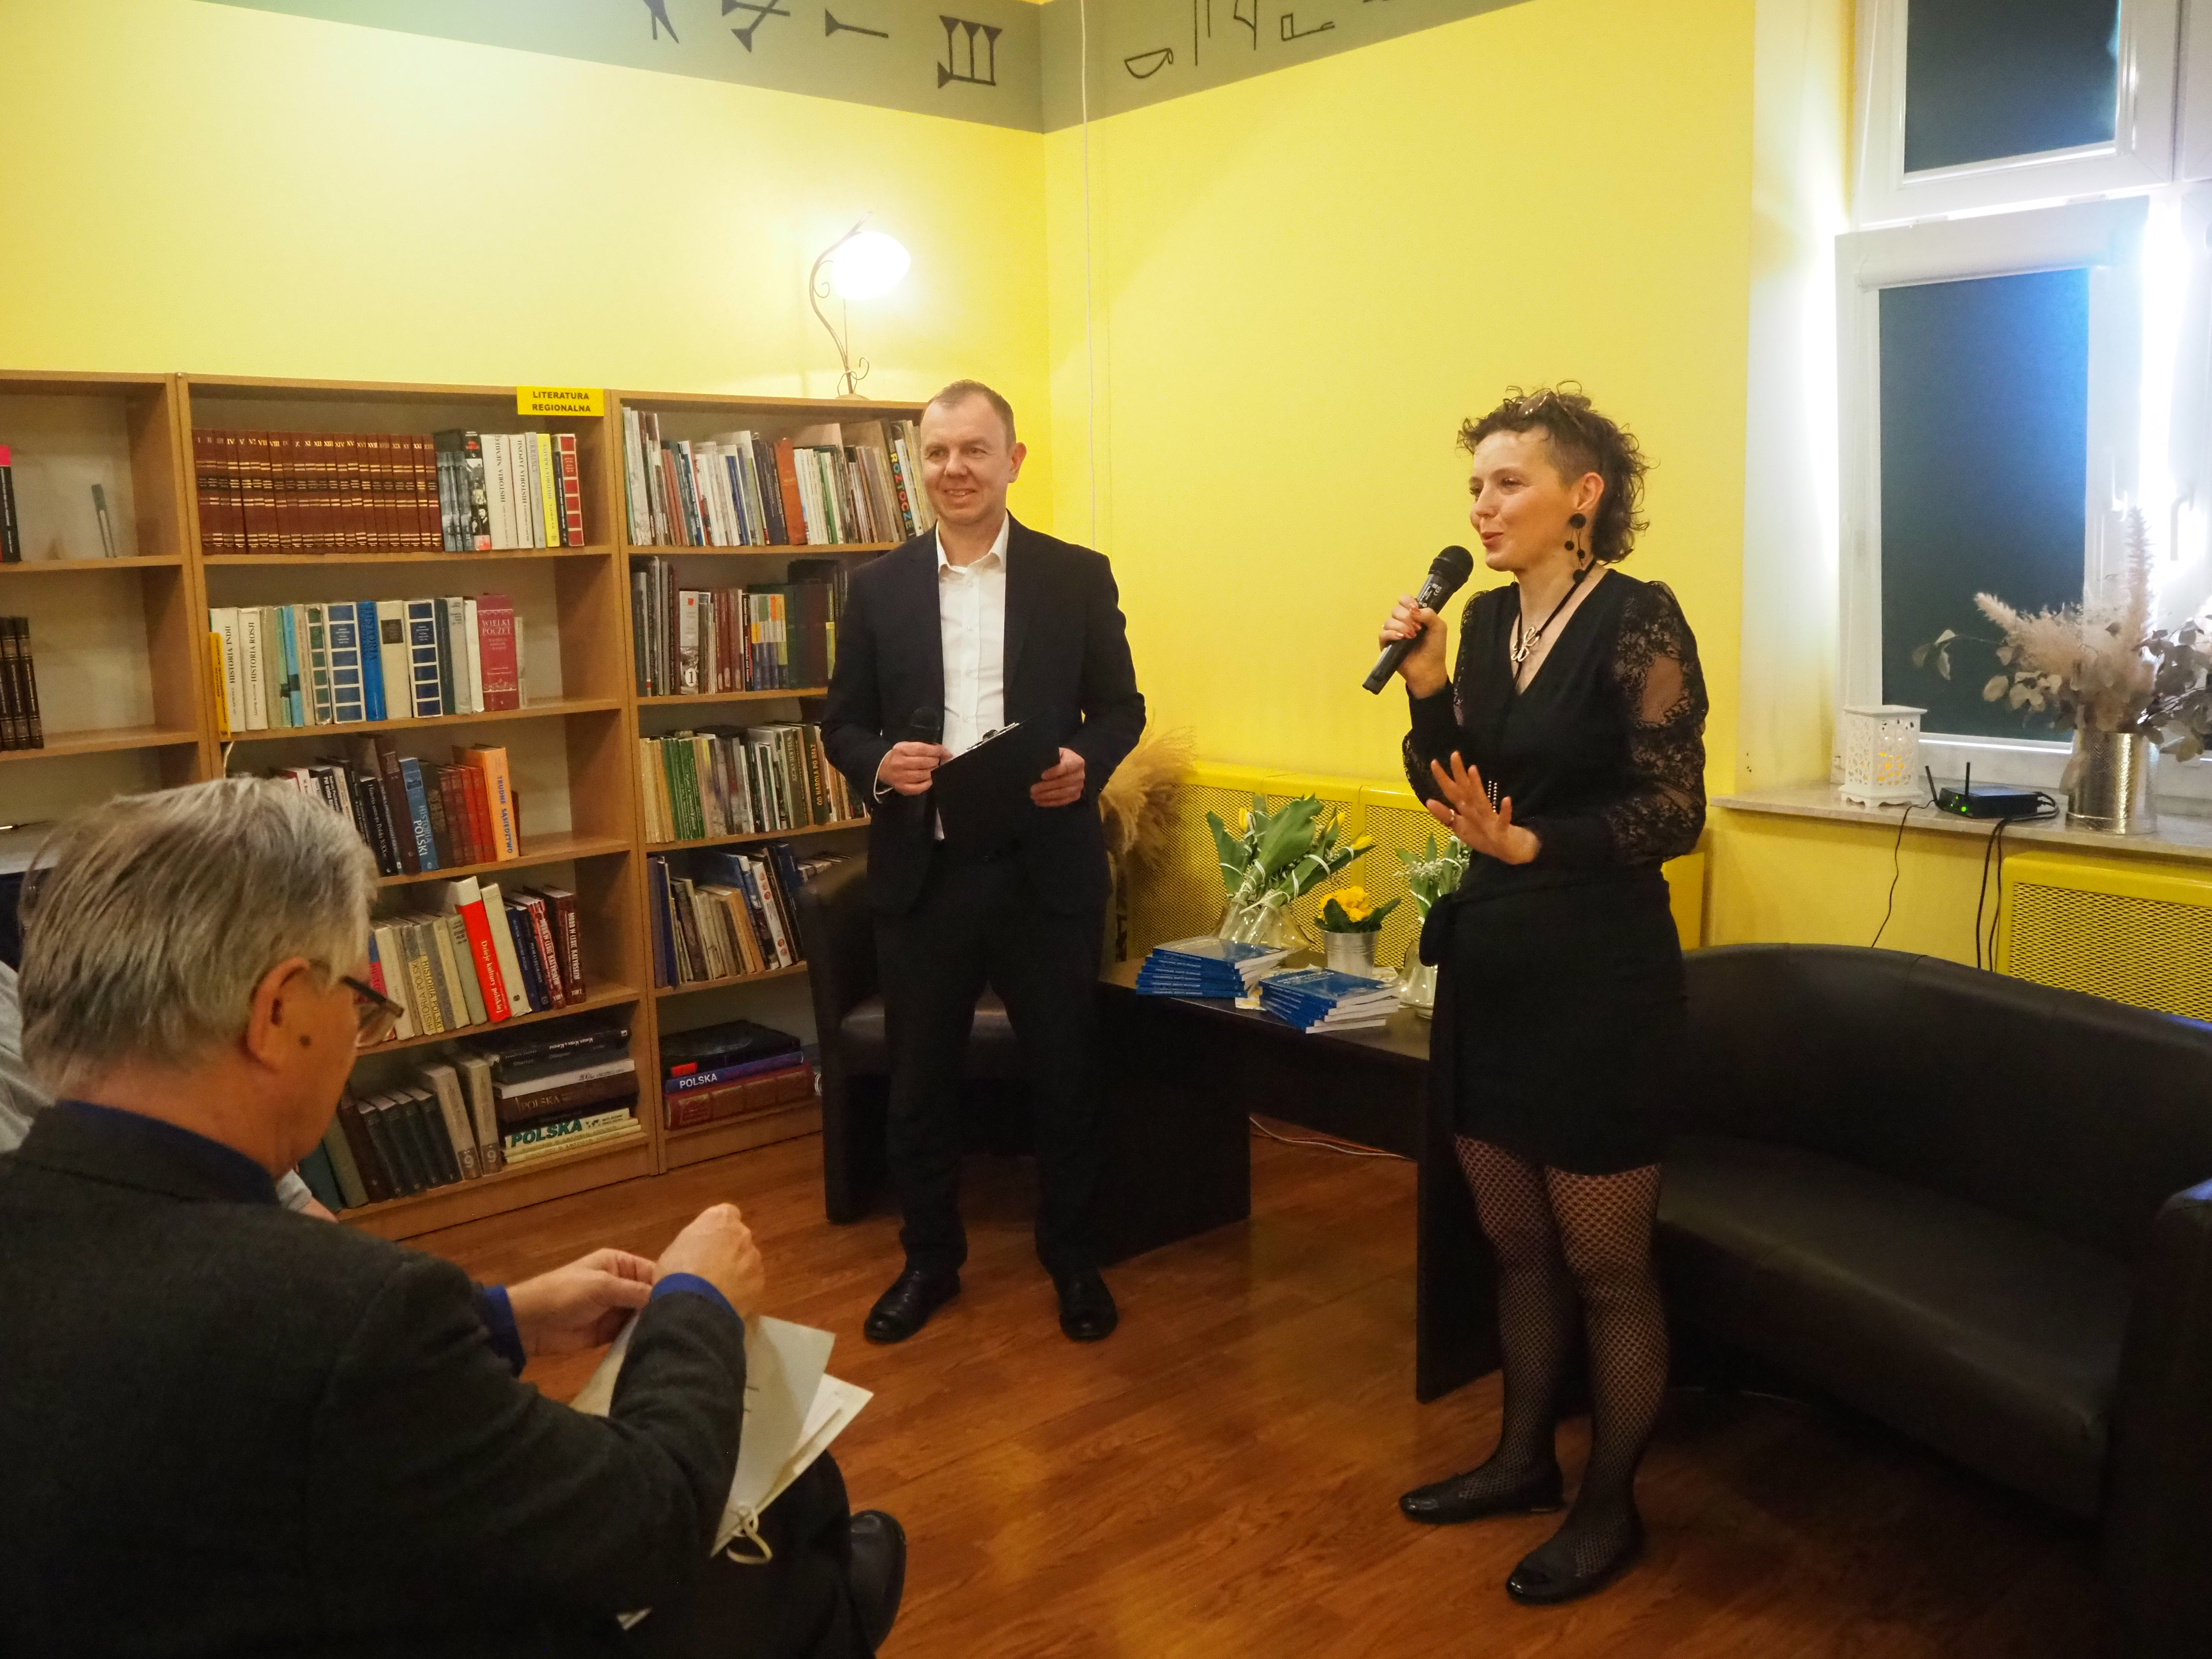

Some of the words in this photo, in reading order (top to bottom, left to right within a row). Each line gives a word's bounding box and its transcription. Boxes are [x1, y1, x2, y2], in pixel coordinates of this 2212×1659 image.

[532, 391, 589, 400] LITERATURA
[532, 403, 591, 412] REGIONALNA
[498, 469, 506, 503] HISTORIA
[890, 453, 913, 529] ROZTOCZE
[227, 648, 235, 684] HISTORIA
[497, 776, 505, 805] TRUDNE
[413, 819, 428, 856] POLSKI
[419, 805, 432, 844] HISTORIA
[481, 939, 490, 965] Dzieje
[571, 949, 580, 980] KATYŃSKIM
[411, 960, 424, 990] POLSKI
[485, 966, 496, 988] kultury
[422, 961, 436, 999] HISTORIA
[432, 1000, 443, 1029] POLSKI
[490, 987, 505, 1014] polskiej
[419, 992, 434, 1032] HISTORIA
[680, 1073, 717, 1089] POLSKA
[521, 1095, 561, 1110] POLSKA
[511, 1119, 583, 1148] POLSKA
[464, 1155, 474, 1168] 9
[487, 1150, 497, 1163] 9
